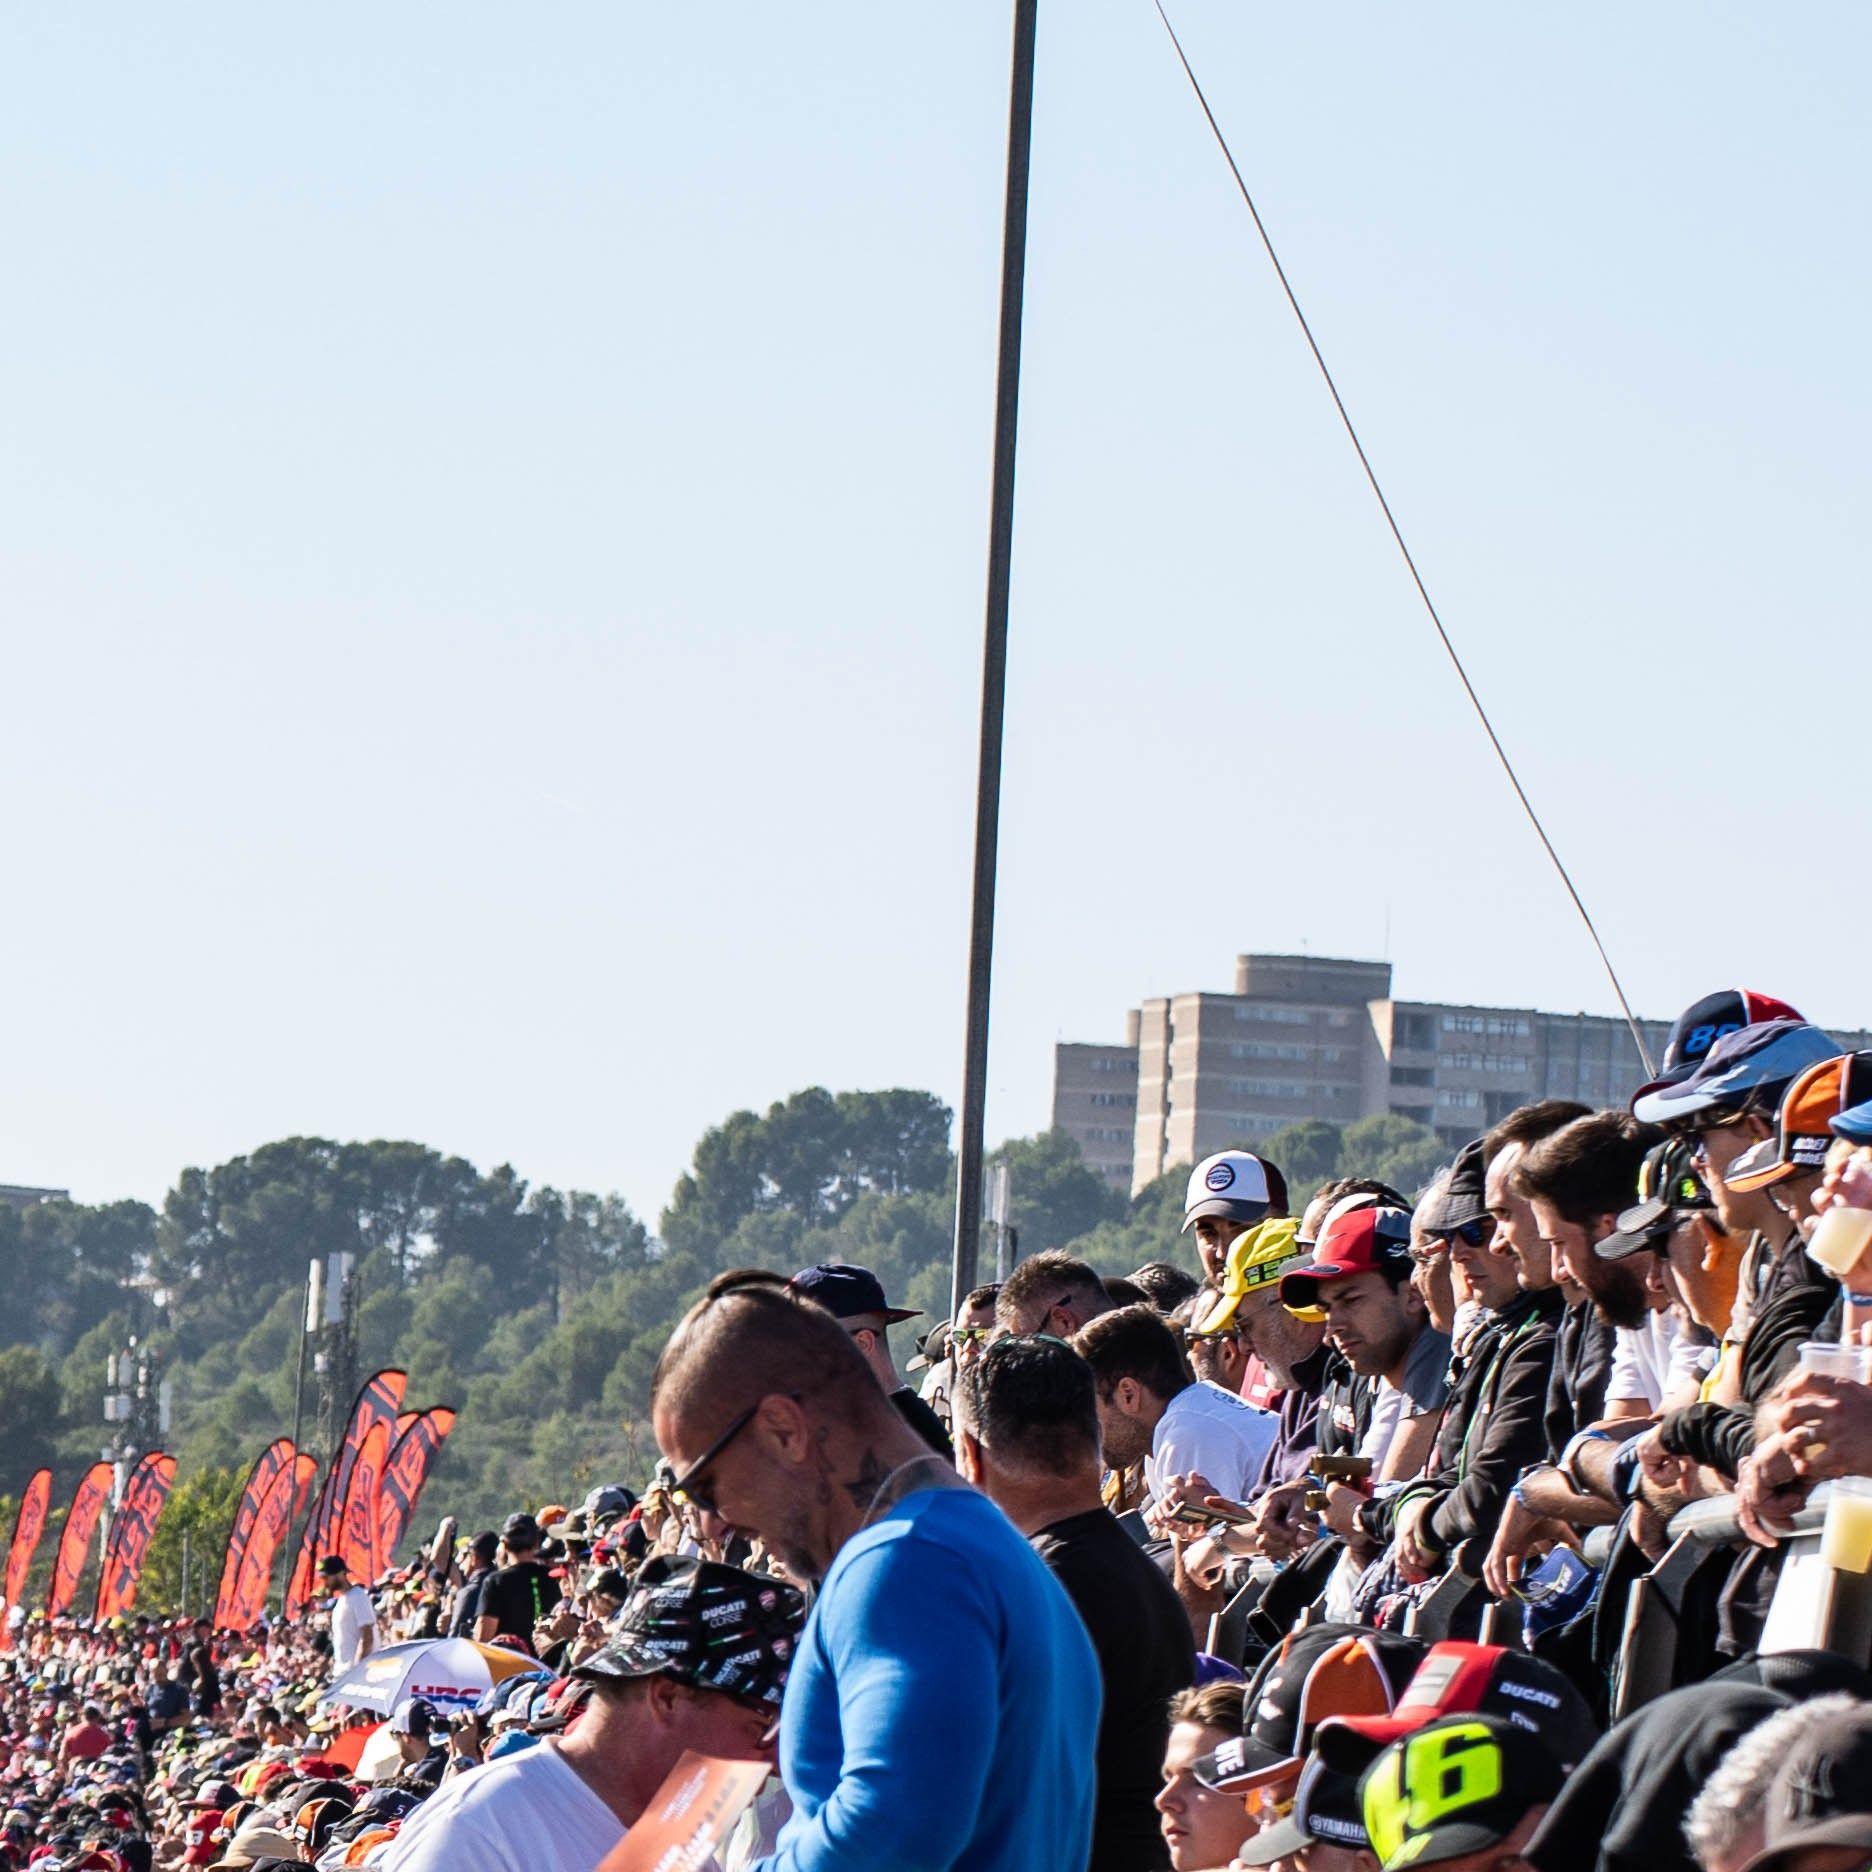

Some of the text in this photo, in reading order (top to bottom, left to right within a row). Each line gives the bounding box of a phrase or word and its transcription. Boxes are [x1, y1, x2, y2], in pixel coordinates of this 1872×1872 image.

[701, 1600, 747, 1622] DUCATI
[709, 1612, 744, 1629] CORSE
[645, 1639, 690, 1652] DUCATI
[1498, 1681, 1562, 1709] DUCATI
[1320, 1816, 1368, 1840] YAMAHA
